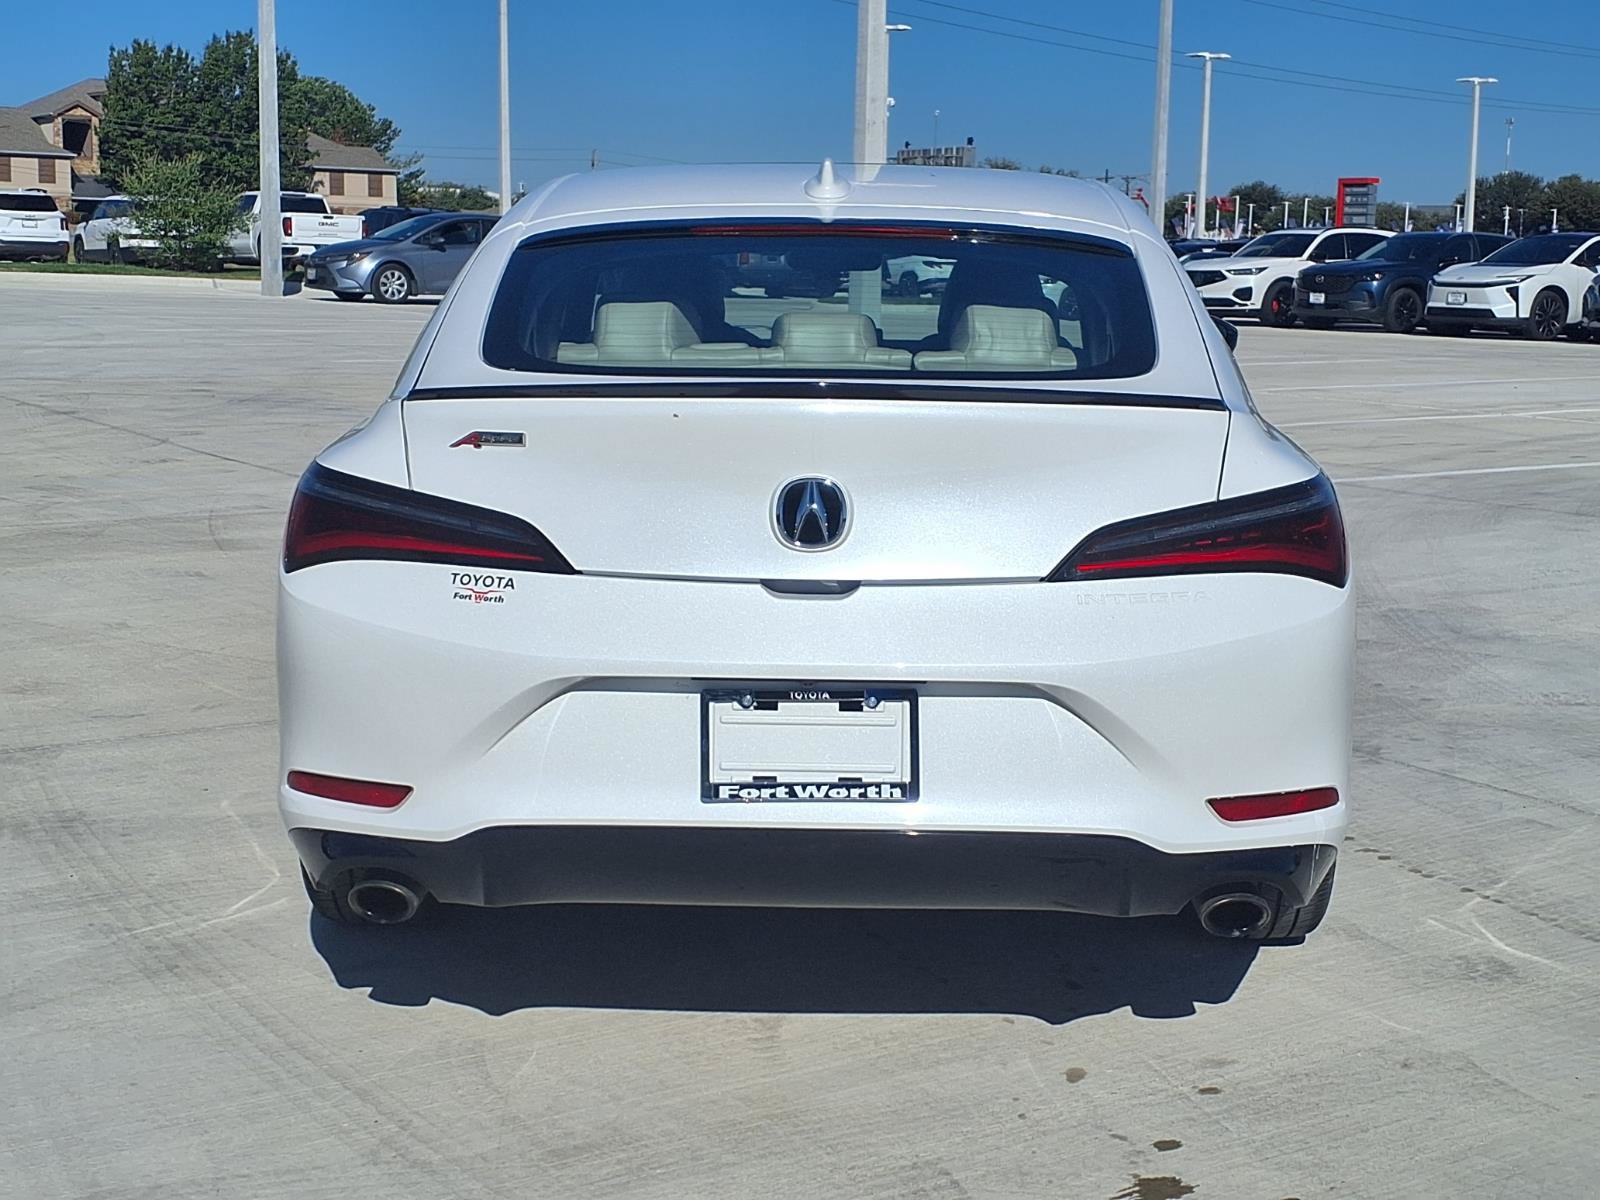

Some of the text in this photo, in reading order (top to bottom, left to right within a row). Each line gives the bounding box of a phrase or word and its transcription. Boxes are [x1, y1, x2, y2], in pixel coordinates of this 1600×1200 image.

[451, 573, 515, 590] TOYOTA
[453, 592, 504, 604] Fort Worth
[790, 691, 830, 700] TOYOTA
[718, 784, 902, 800] Fort Worth
